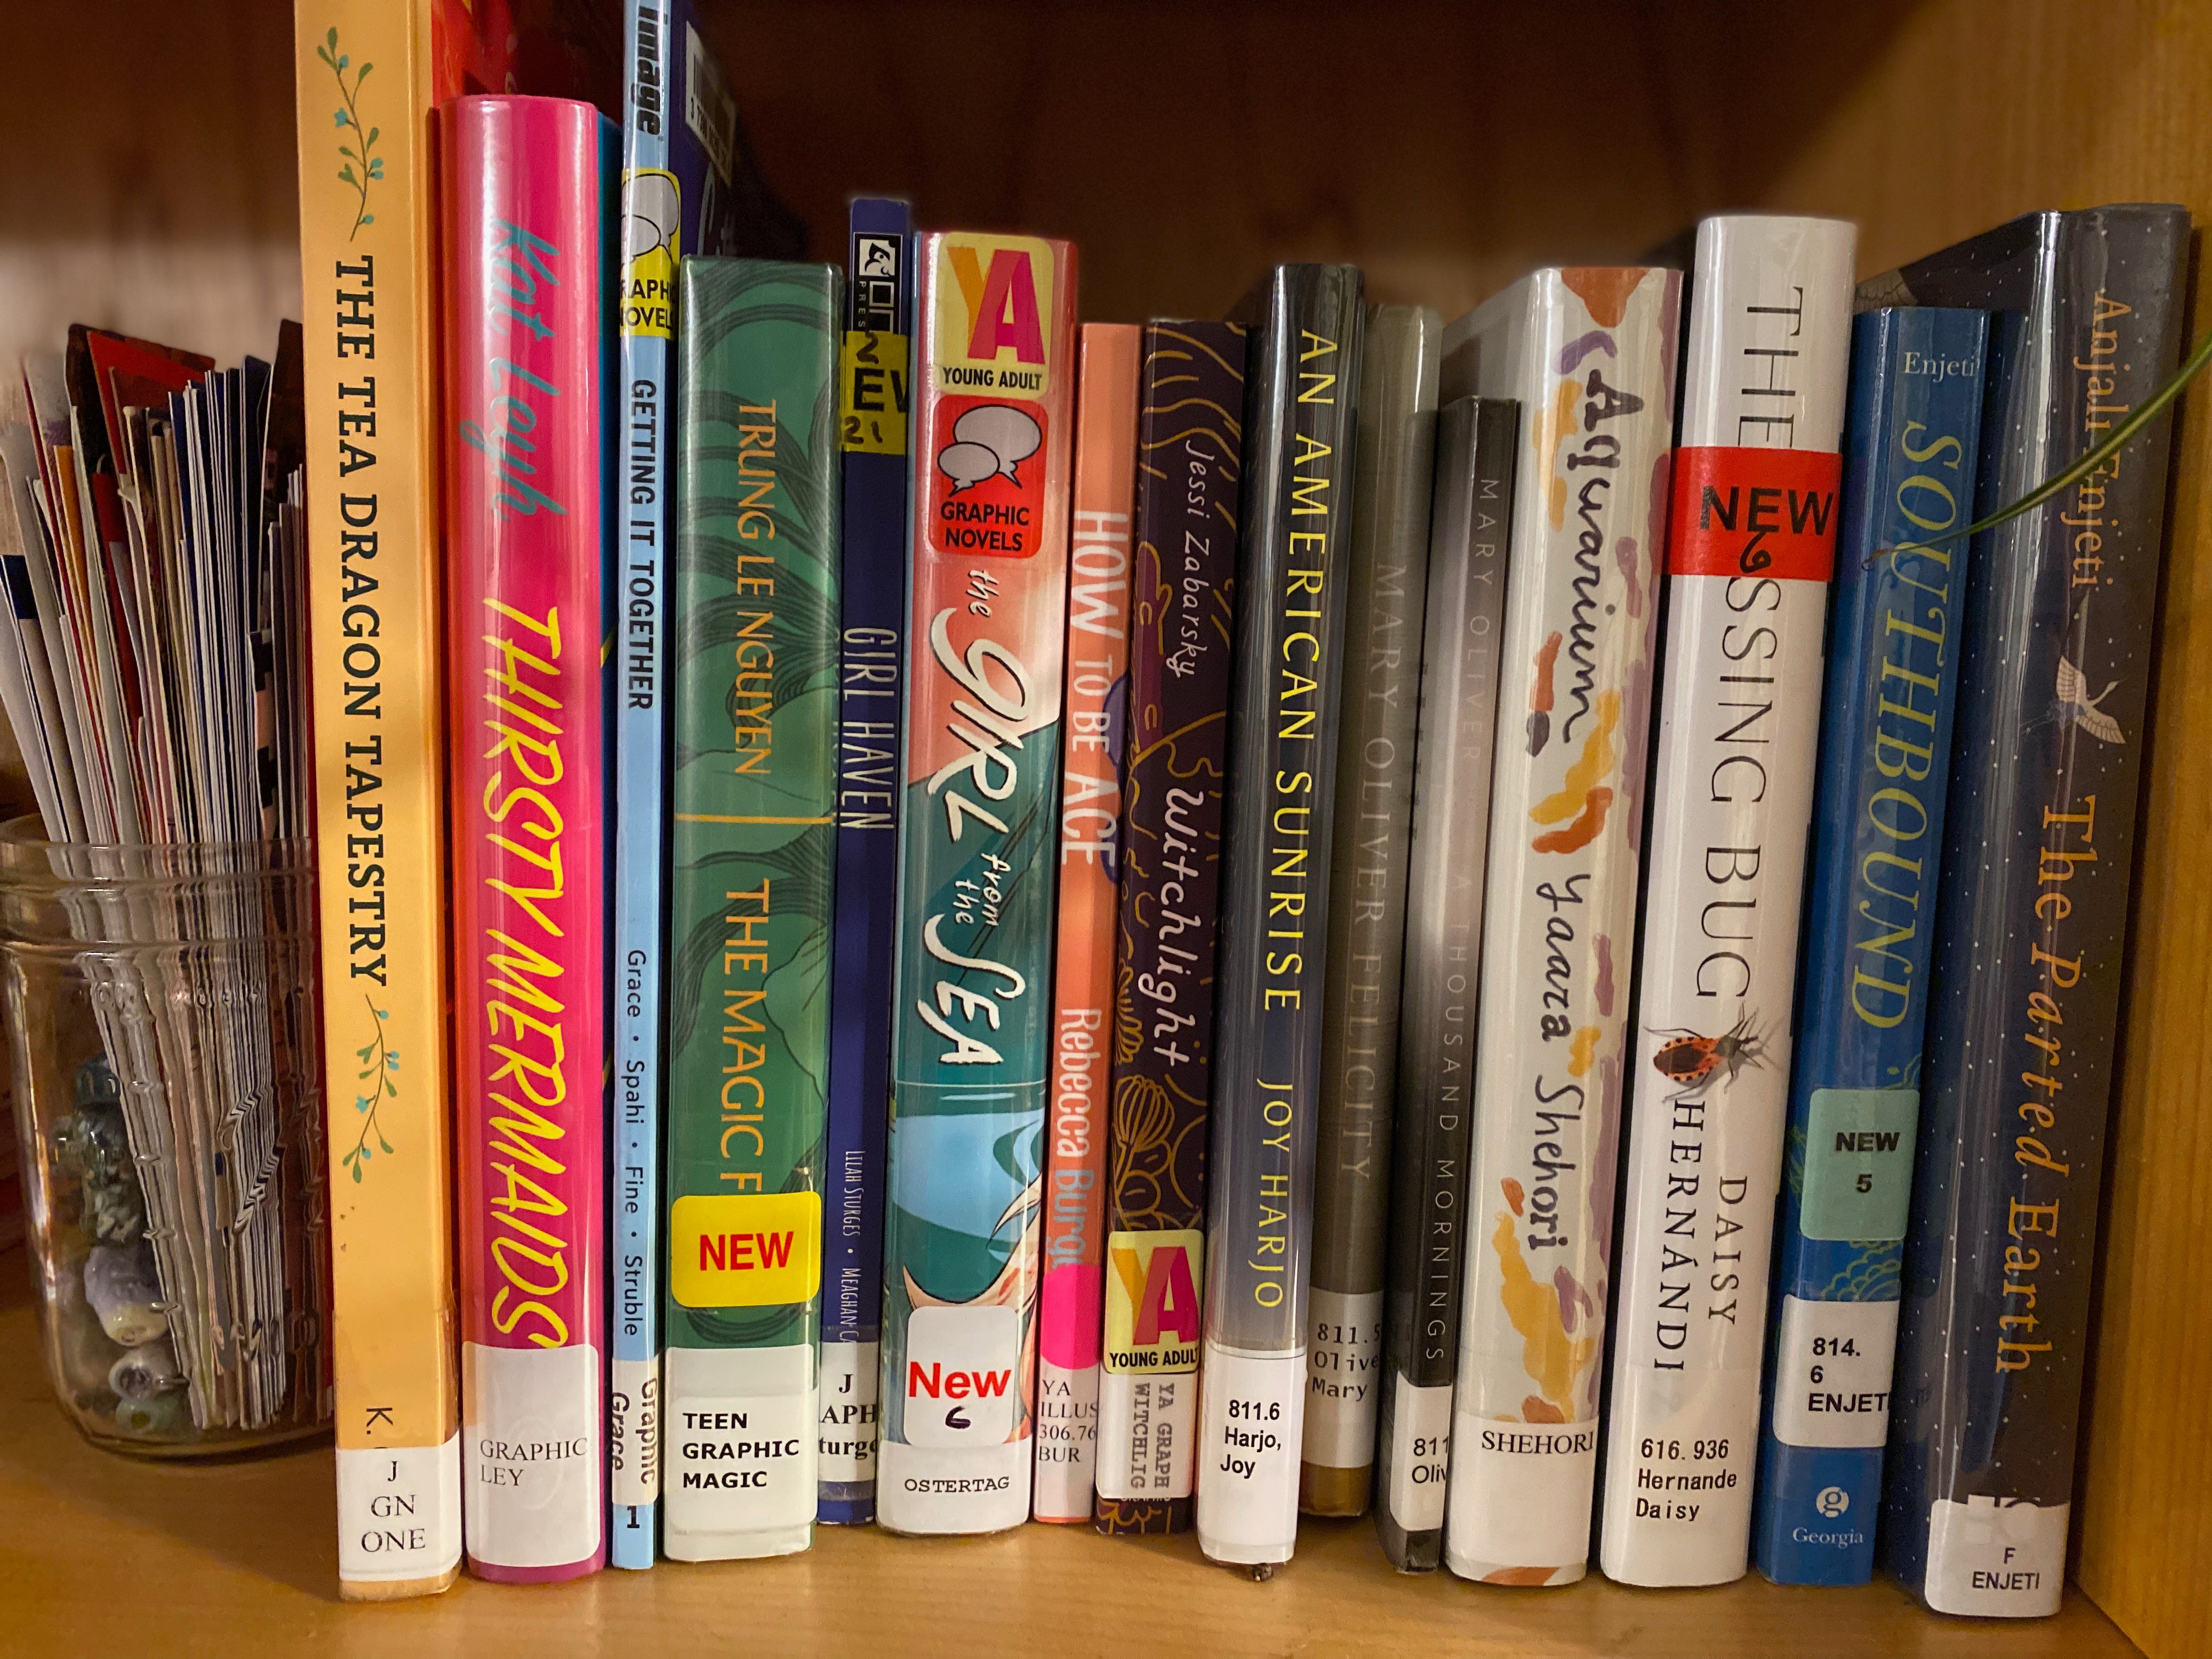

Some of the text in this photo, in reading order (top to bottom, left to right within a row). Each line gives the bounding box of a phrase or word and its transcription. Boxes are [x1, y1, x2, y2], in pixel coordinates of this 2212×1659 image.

[947, 246, 1045, 364] YA
[459, 218, 567, 521] Kat Leyh
[943, 367, 1042, 390] YOUNG ADULT
[1738, 286, 1803, 448] THE
[1904, 352, 1979, 382] Enjeti
[941, 501, 1029, 525] GRAPHIC
[1701, 486, 1833, 536] NEW
[628, 379, 657, 709] GETTING IT TOGETHER
[945, 528, 1023, 551] NOVELS
[1166, 440, 1215, 678] Jessi Zabarsky
[1739, 531, 1772, 574] 6
[735, 399, 776, 774] TRUNG LE NGUYEN
[966, 569, 1000, 617] the
[336, 255, 387, 986] THE TEA DRAGON TAPESTRY
[1461, 479, 1499, 761] MARY OLIVER
[1062, 511, 1129, 867] HOW TO BE ACE
[1264, 329, 1338, 1011] AN AMERICAN SUNRISE
[840, 627, 898, 830] GIRL HAVEN
[1852, 420, 1962, 1029] SOUTHBOUND
[1527, 369, 1645, 1251] Aquarium Yaara Shehori
[980, 853, 1011, 926] from
[1341, 565, 1407, 1181] MARY OLIVER FELICITY
[952, 878, 980, 926] the
[1696, 845, 1762, 997] BUG
[724, 878, 769, 975] THE
[1138, 788, 1205, 1066] Witchlight
[482, 598, 569, 1348] THIRSTY MERMAIDS
[916, 913, 1026, 1065] SEA
[1440, 921, 1470, 1131] THOUSAND
[720, 990, 767, 1158] MAGIC
[1056, 1008, 1103, 1158] Rebecca
[1995, 795, 2098, 1374] The Parted Earth
[621, 950, 647, 1336] Grace Spahi Fine Struble
[1835, 1132, 1900, 1153] NEW
[1248, 1079, 1293, 1307] JOY HARJO
[1856, 1173, 1872, 1193] 5
[699, 1232, 794, 1271] NEW
[1426, 1159, 1455, 1359] MORNINGS
[1708, 1176, 1748, 1325] DAISY
[840, 1268, 861, 1325] MEAGHAN
[1111, 1246, 1199, 1345] YA
[1109, 1351, 1158, 1368] YOUNG
[1813, 1337, 1861, 1357] 814.
[839, 1374, 854, 1393] J
[909, 1362, 1012, 1400] New
[1042, 1380, 1071, 1396] YA
[1312, 1376, 1367, 1402] Mary
[1810, 1365, 1823, 1384] 6
[611, 1392, 630, 1471] Grace
[636, 1378, 658, 1485] Graphic
[682, 1412, 748, 1429] TEEN
[945, 1406, 971, 1429] 6
[1229, 1400, 1280, 1420] 811.6
[480, 1437, 588, 1462] GRAPHIC
[682, 1440, 799, 1460] GRAPHIC
[1039, 1447, 1080, 1463] BUR
[1131, 1383, 1150, 1488] WITCHLIG
[1154, 1383, 1175, 1488] YA GRAPH
[1224, 1426, 1282, 1452] Harjo,
[1482, 1430, 1594, 1454] SHEHORI
[388, 1460, 398, 1482] J
[481, 1466, 524, 1487] LEY
[683, 1471, 768, 1489] MAGIC
[905, 1476, 1009, 1493] OSTERTAG
[1220, 1454, 1256, 1479] Joy
[1638, 1468, 1737, 1491] Hernande
[371, 1494, 416, 1517] GN
[627, 1506, 640, 1528] 1
[1636, 1498, 1700, 1521] Daisy
[361, 1528, 426, 1553] ONE
[1792, 1527, 1863, 1549] Georgia
[2004, 1547, 2016, 1564] F
[1972, 1571, 2040, 1590] ENJETI
